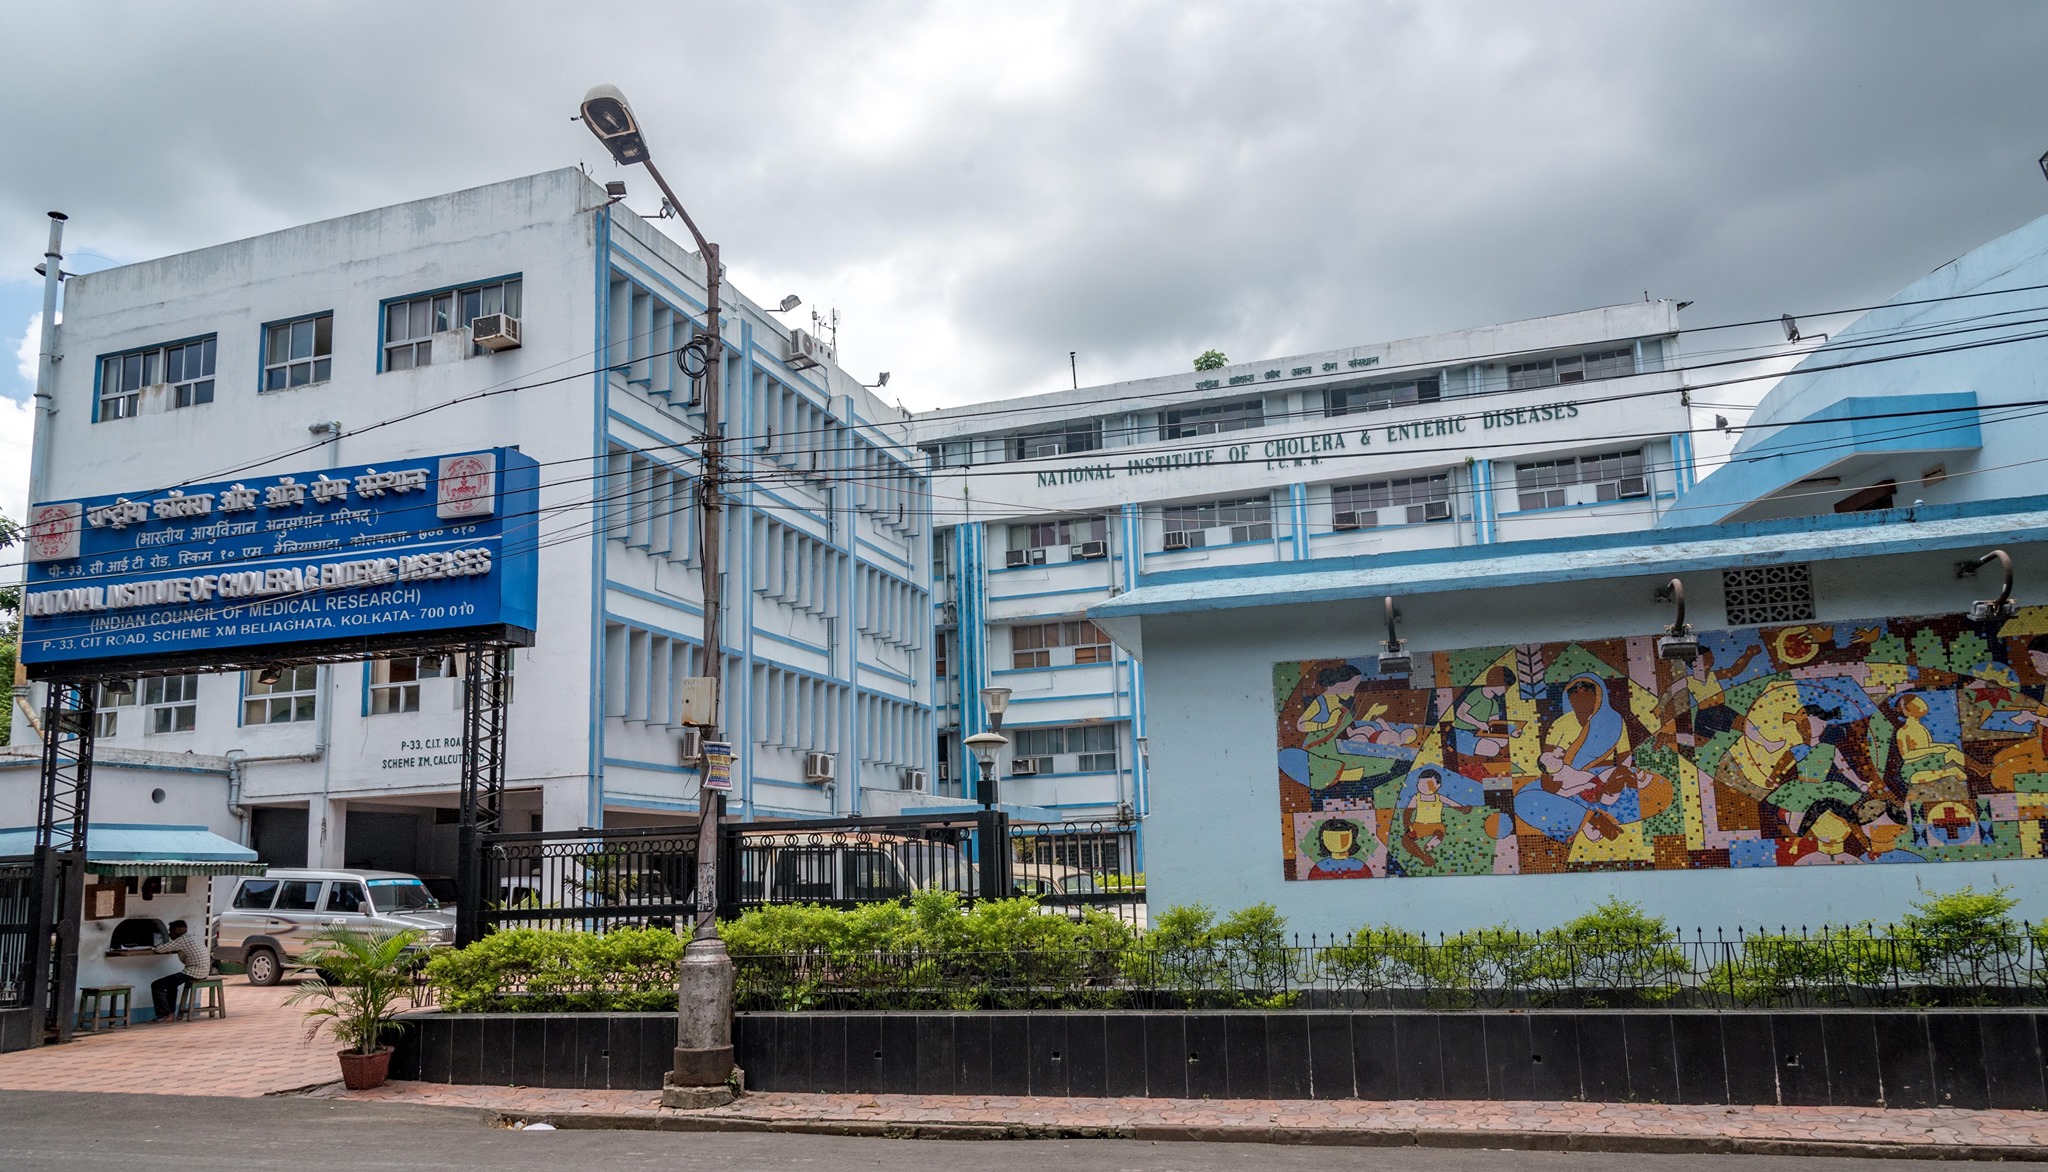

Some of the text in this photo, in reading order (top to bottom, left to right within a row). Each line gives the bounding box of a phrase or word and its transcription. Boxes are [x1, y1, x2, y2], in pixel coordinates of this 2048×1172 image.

[1037, 400, 1579, 488] NATIONAL INSTITUTE OF CHOLERA & ENTERIC DISEASES
[217, 483, 260, 513] और
[311, 474, 351, 504] रोग
[135, 526, 185, 549] (भारतीय
[25, 547, 492, 617] NATIONAL INSTITUTE OF CHOLERA & ENTERIC DISEASES
[80, 636, 102, 648] CIT
[153, 626, 211, 642] SCHEME
[215, 624, 236, 636] XM
[419, 606, 445, 619] 700
[449, 604, 475, 617] 010
[90, 588, 422, 635] (INDIAN COUNCIL OF MEDICAL RESEARCH)
[382, 757, 415, 769] SCHEME
[444, 737, 464, 748] ROA
